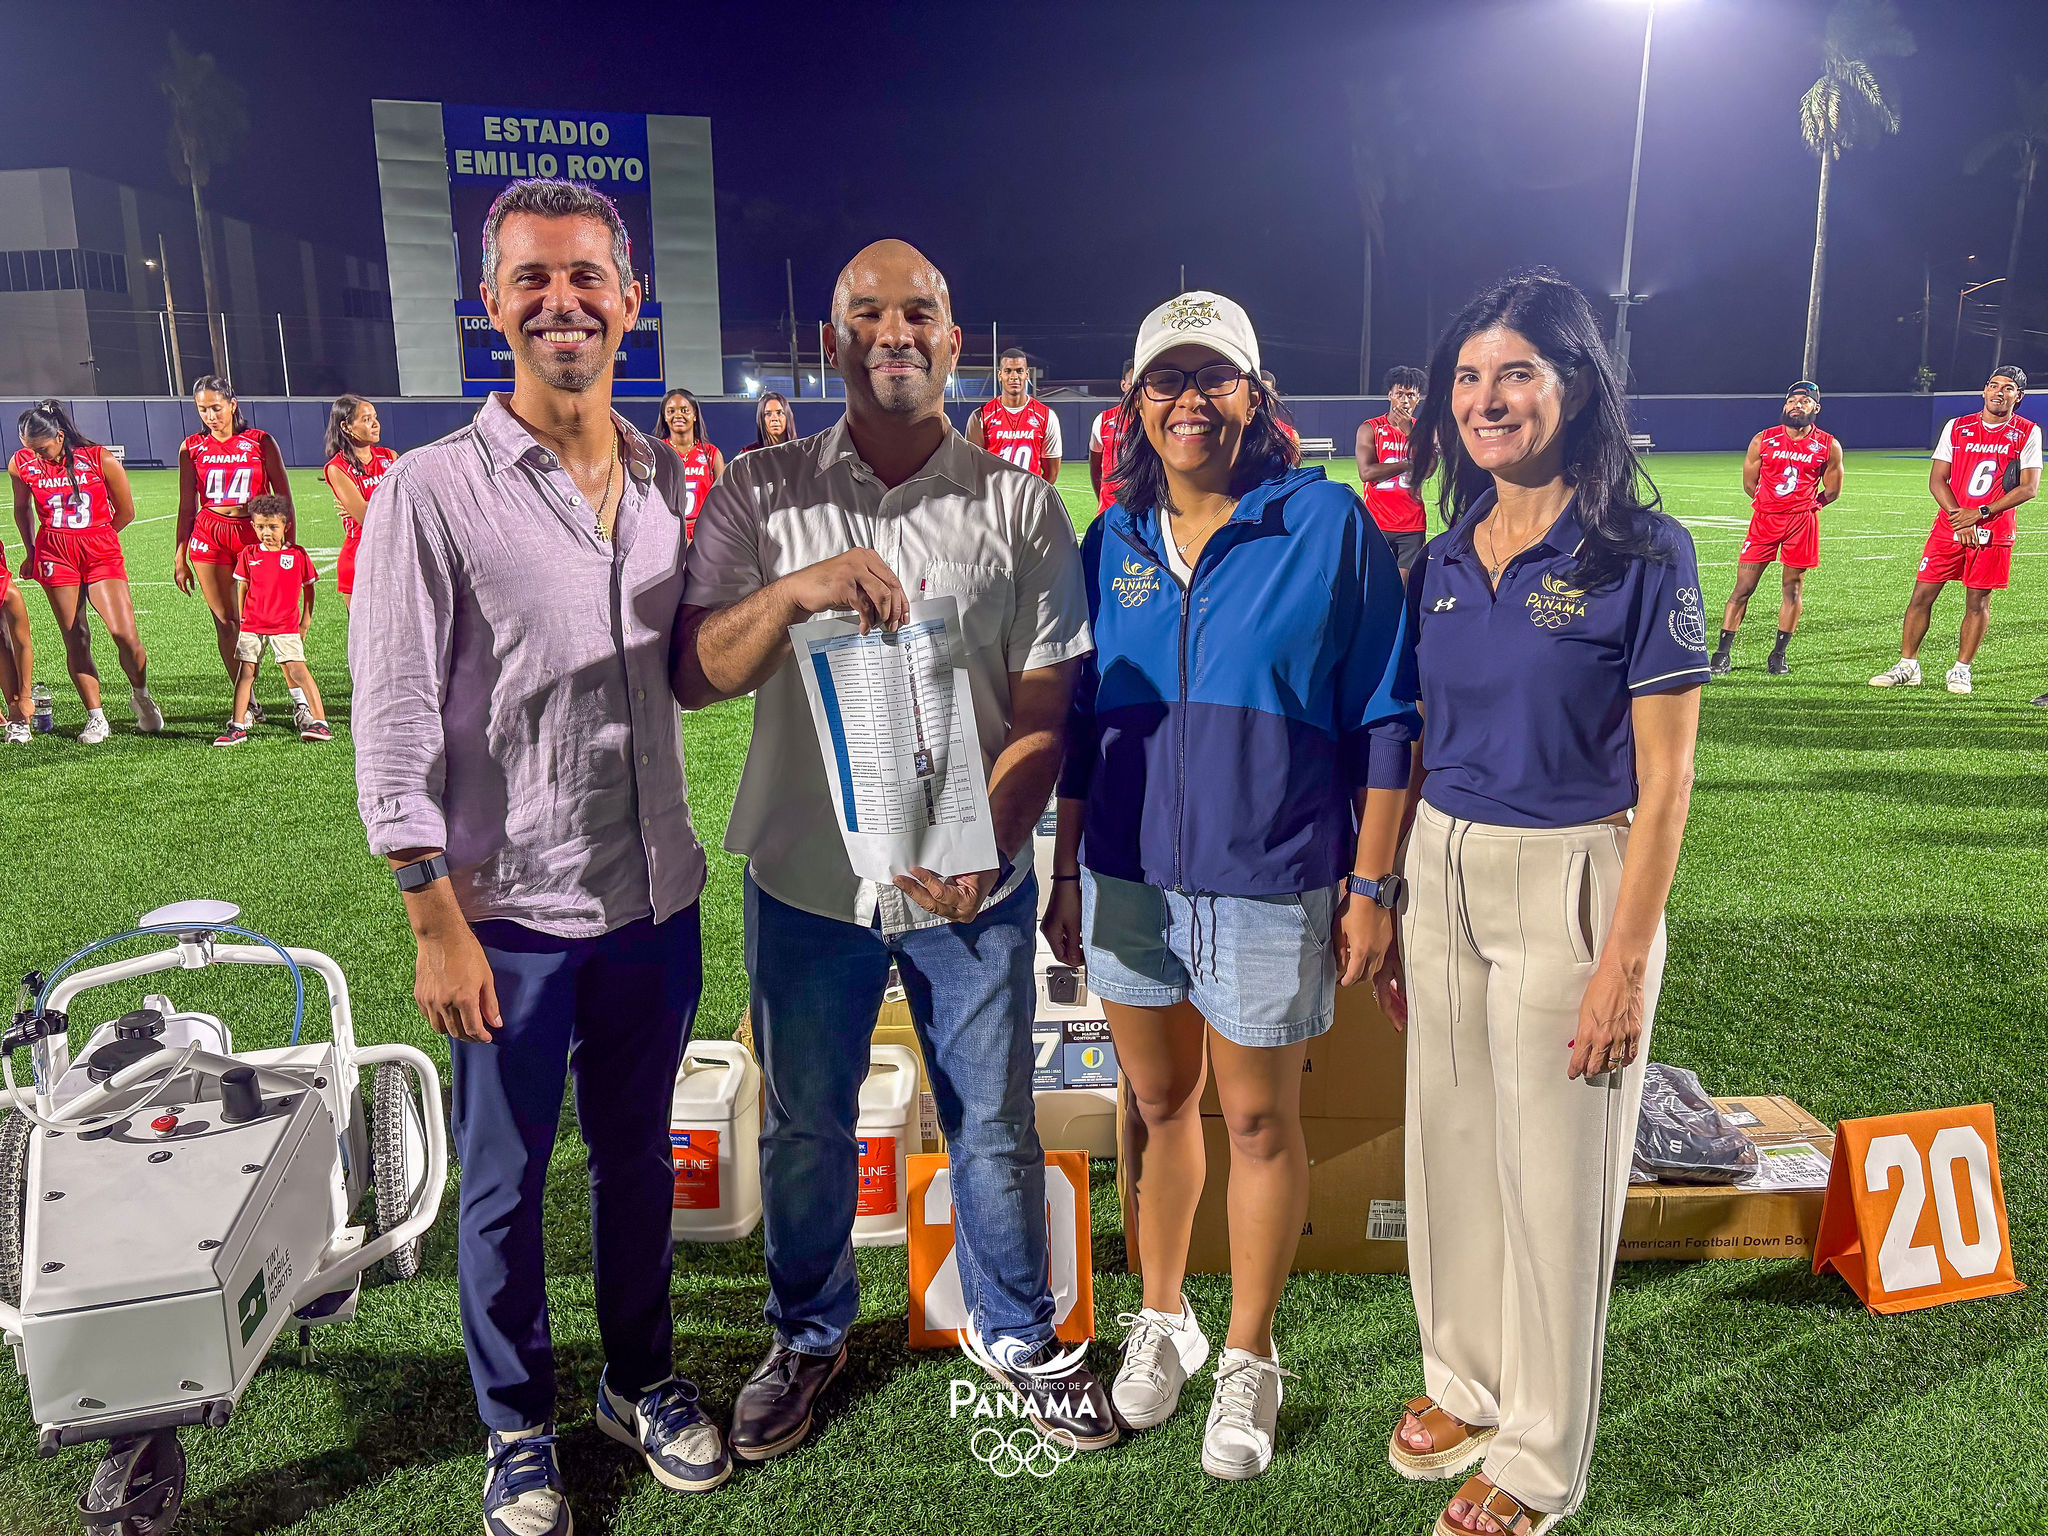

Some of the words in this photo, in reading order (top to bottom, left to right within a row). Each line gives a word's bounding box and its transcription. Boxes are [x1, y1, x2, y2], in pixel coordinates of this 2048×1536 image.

[483, 116, 610, 147] ESTADIO
[455, 149, 558, 178] EMILIO
[567, 155, 644, 182] ROYO
[464, 318, 495, 330] LOCA
[632, 319, 658, 331] ANTE
[202, 452, 248, 464] PANAMÁ
[1772, 450, 1815, 464] PANAMÁ
[1964, 442, 2012, 455] PANAMÁ
[685, 465, 705, 476] AMÁ
[1774, 465, 1800, 497] 3
[1966, 458, 1998, 498] 6
[205, 467, 253, 504] 44
[46, 492, 92, 529] 13
[190, 537, 209, 553] 44
[1918, 556, 1929, 572] 6
[1111, 577, 1161, 591] PANAMÁ
[1525, 592, 1588, 617] PANAMÁ
[1863, 1124, 2002, 1293] 20
[1619, 1238, 1681, 1249] American
[1685, 1236, 1739, 1248] Football
[1743, 1236, 1780, 1247] Down
[1784, 1235, 1810, 1246] Box
[266, 1243, 279, 1271] TINY
[268, 1248, 290, 1288] MOBILE
[270, 1264, 293, 1305] ROBOTS
